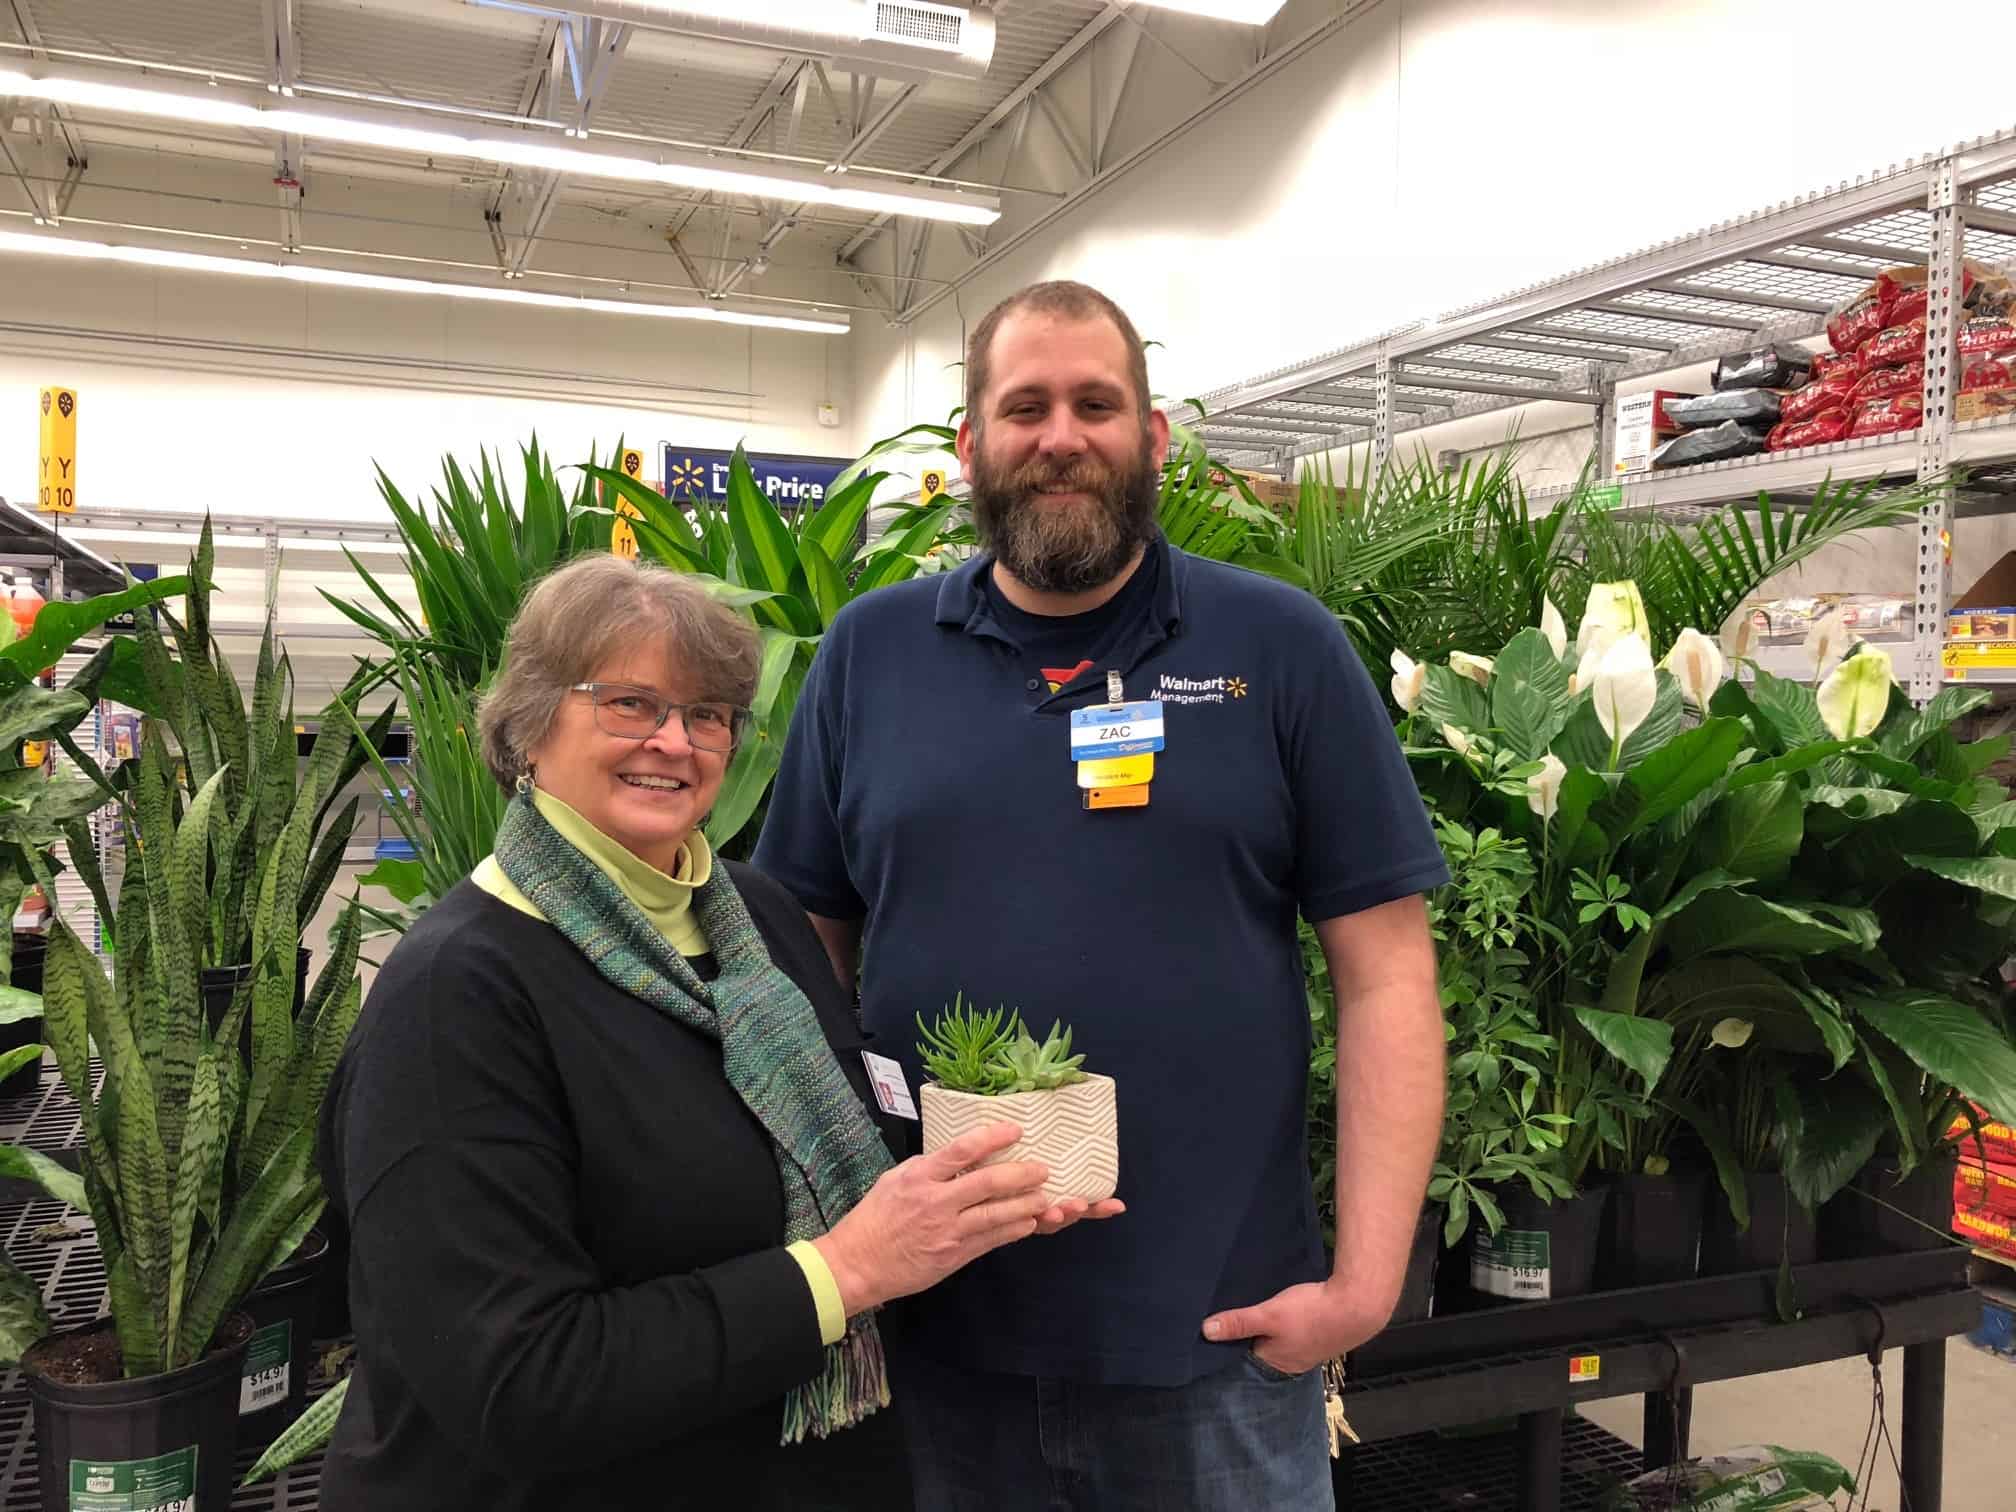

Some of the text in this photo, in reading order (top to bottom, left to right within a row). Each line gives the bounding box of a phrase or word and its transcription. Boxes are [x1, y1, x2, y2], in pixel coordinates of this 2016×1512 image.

[1855, 413, 1903, 426] HERRY
[58, 456, 72, 479] Y
[766, 475, 824, 500] Price
[56, 487, 73, 507] 10
[619, 537, 632, 555] 11
[1160, 674, 1226, 691] Walmart
[1150, 689, 1224, 704] Management
[1099, 725, 1131, 740] ZAC
